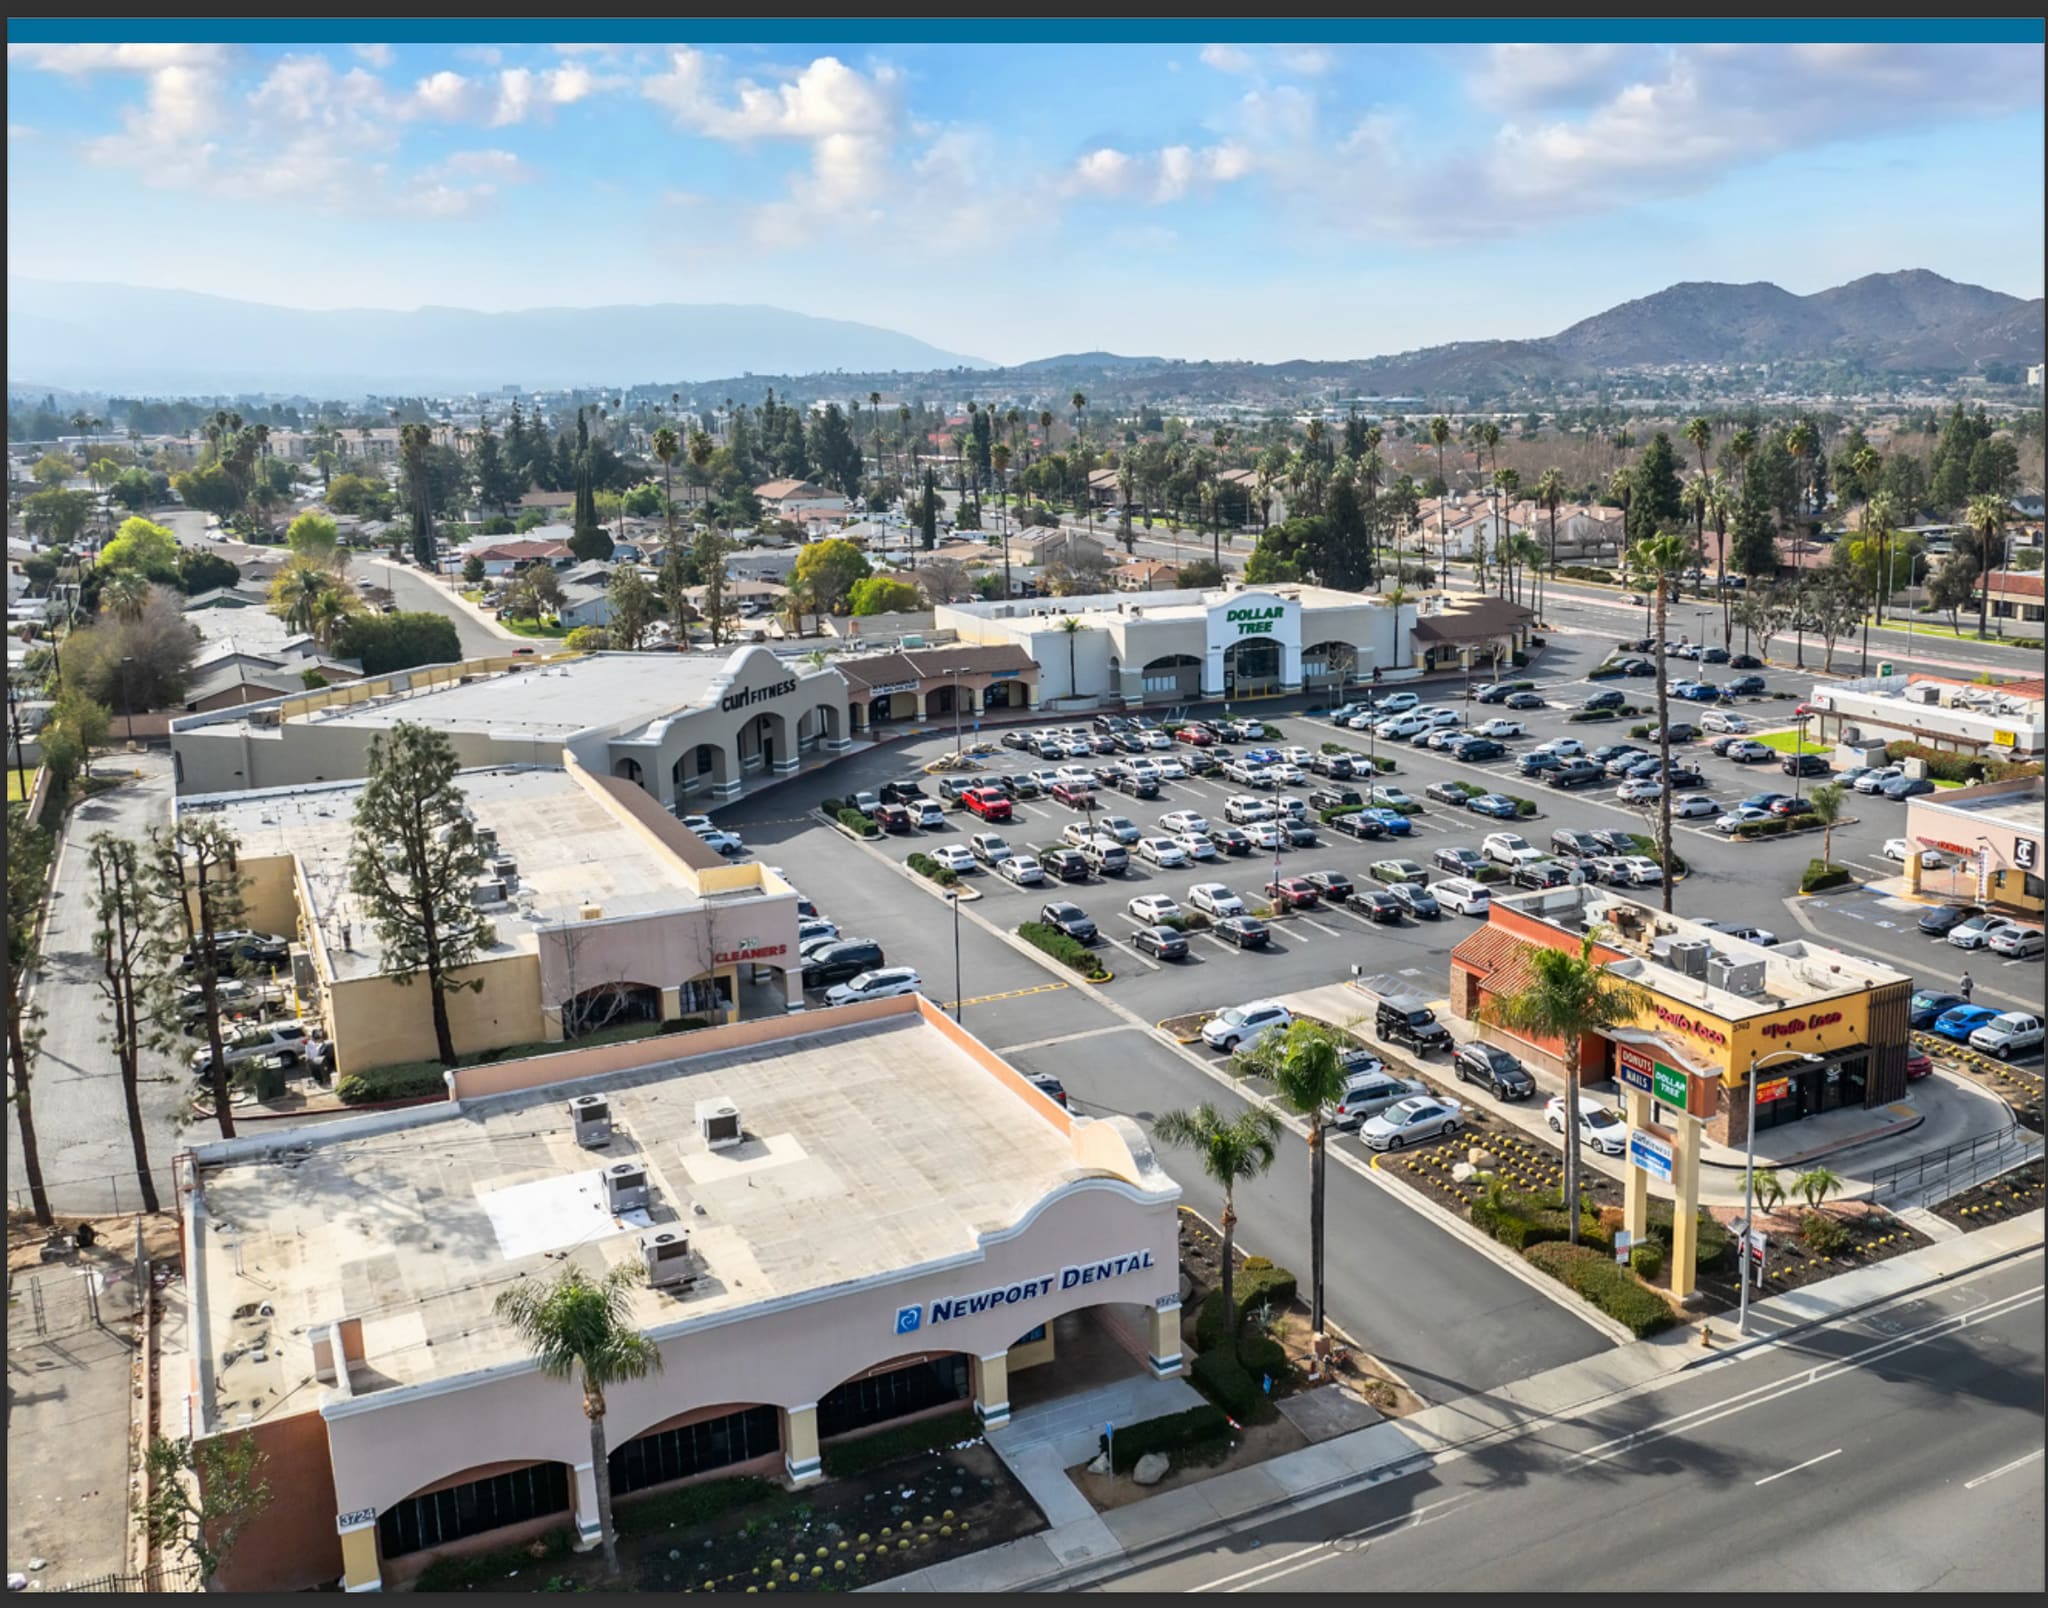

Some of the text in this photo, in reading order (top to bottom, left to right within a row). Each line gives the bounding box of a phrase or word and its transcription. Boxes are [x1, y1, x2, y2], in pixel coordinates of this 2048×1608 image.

[1226, 606, 1284, 622] DOLLAR
[1237, 621, 1273, 634] TREE
[751, 679, 797, 704] FITNESS
[715, 944, 787, 963] CLEANERS
[1656, 1004, 1726, 1046] Pollo Loco
[1808, 1012, 1843, 1030] Loco
[1622, 1050, 1652, 1072] DONUTS
[1626, 1069, 1648, 1089] NAILS
[1655, 1071, 1686, 1092] DOLLAR
[1661, 1084, 1680, 1098] TREE
[931, 1251, 1155, 1324] NEWPORT DENTAL
[341, 1508, 374, 1526] 3724
